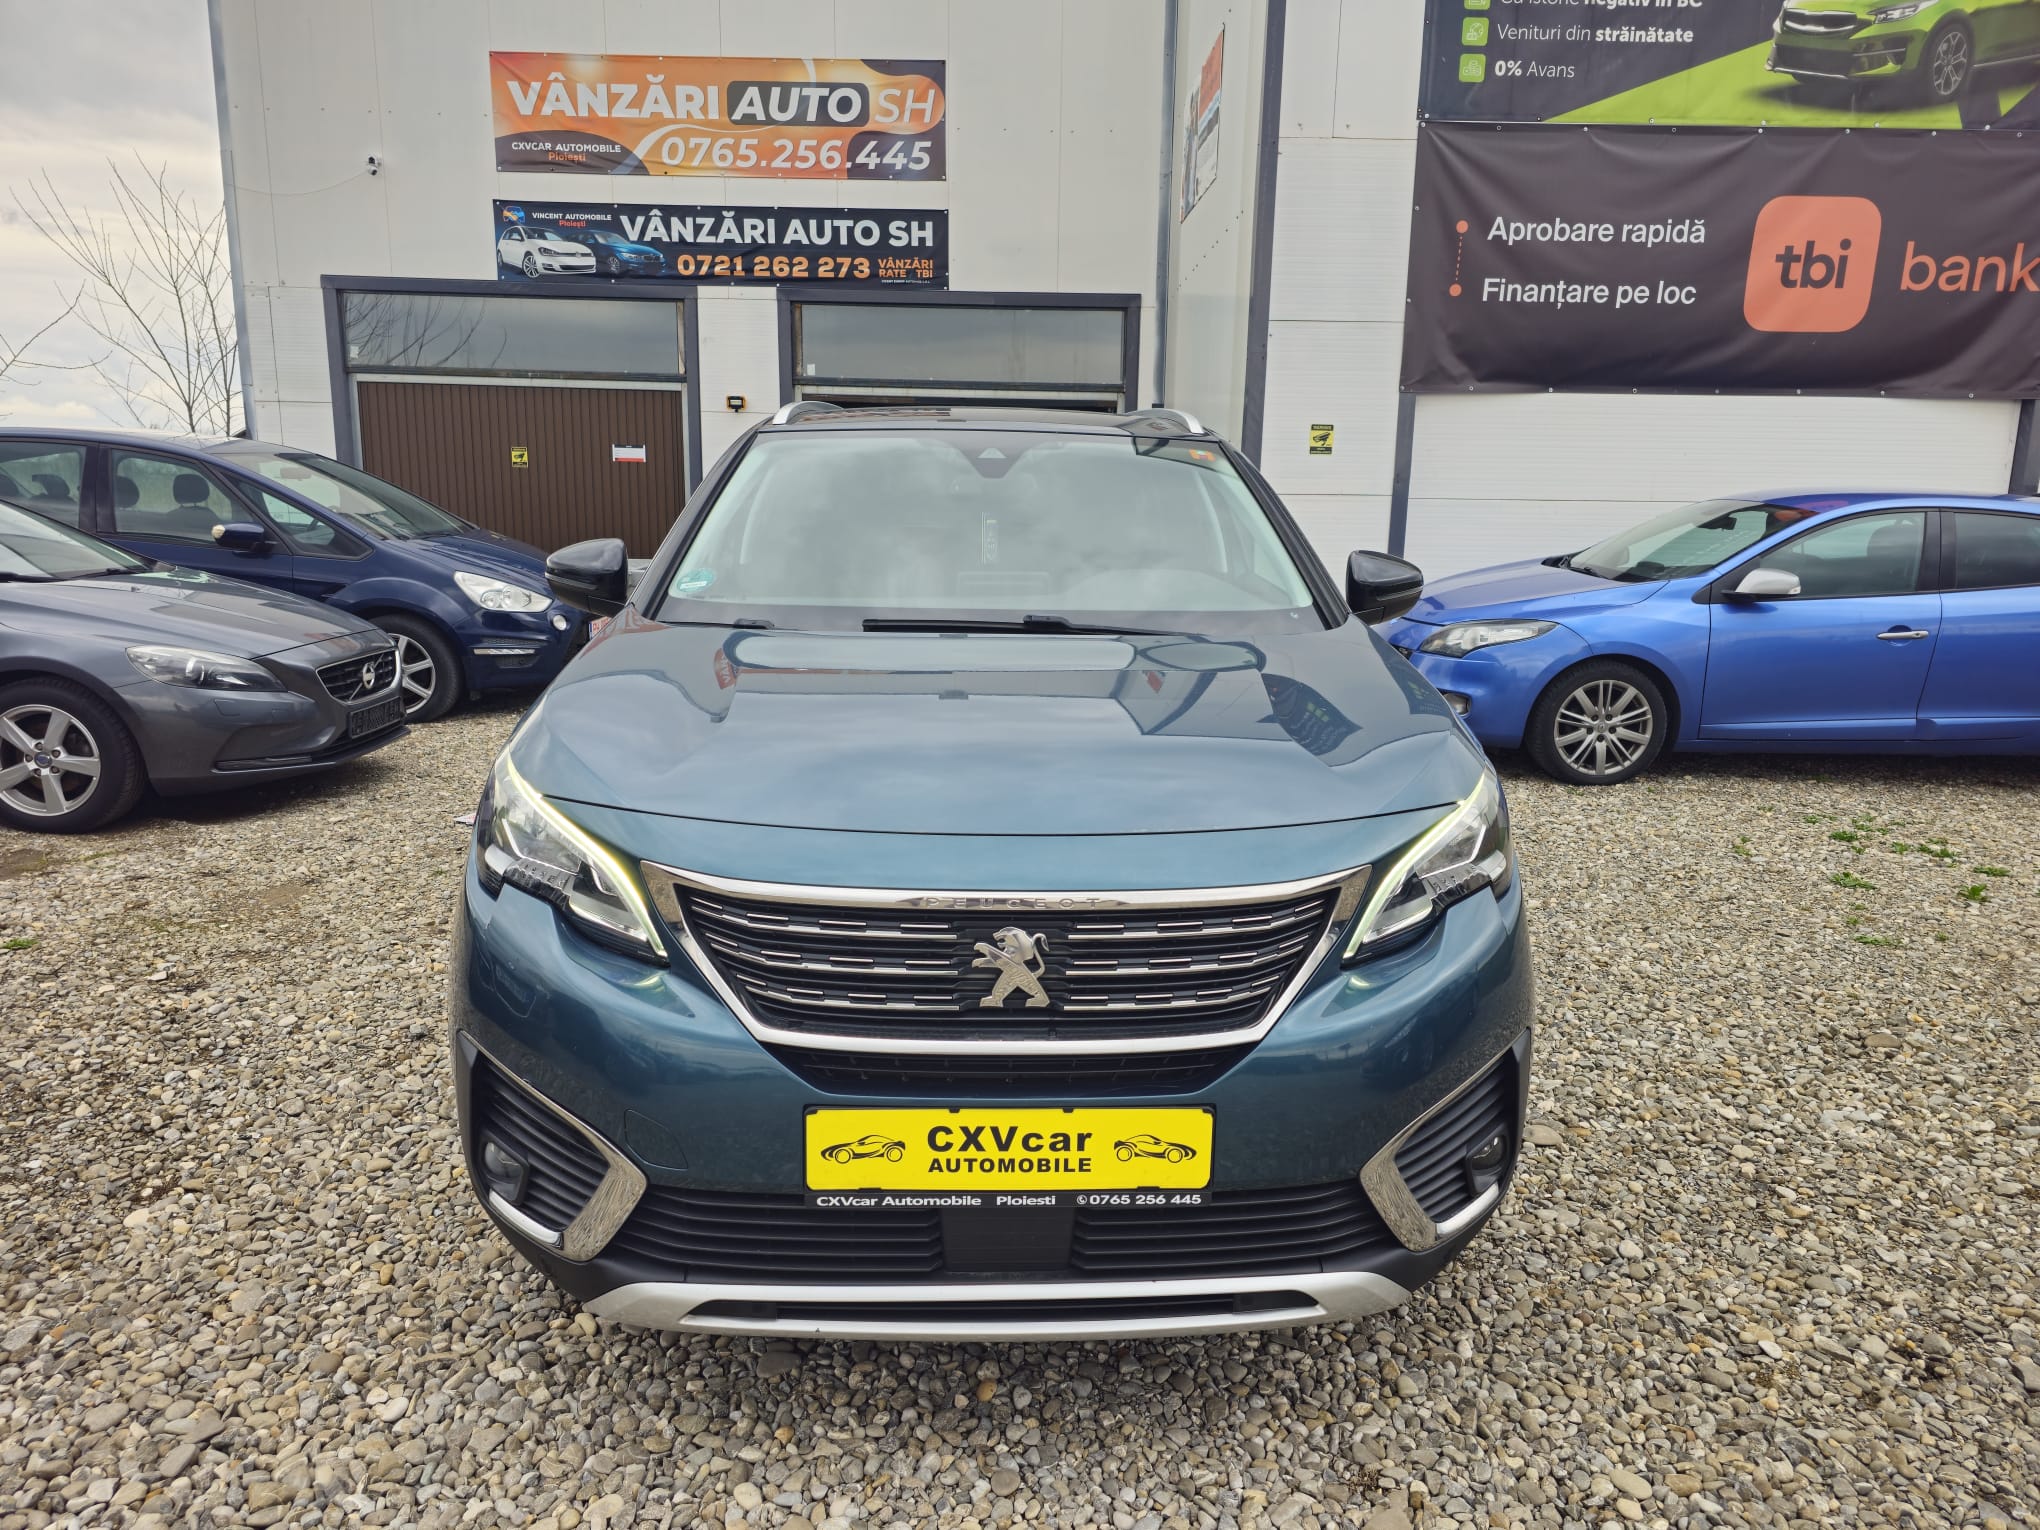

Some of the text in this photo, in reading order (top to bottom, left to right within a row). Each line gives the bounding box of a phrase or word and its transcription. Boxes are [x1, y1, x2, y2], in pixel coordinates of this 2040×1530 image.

[1497, 24, 1694, 43] Venituri din străinătate
[1494, 60, 1575, 78] 0% Avans
[506, 72, 935, 124] VÂNZĂRI AUTO SH
[511, 142, 621, 153] CXVCAR AUTOMOBILE
[661, 136, 932, 171] 0765.256.445
[565, 213, 612, 221] AUTOMOBILE
[620, 208, 933, 247] VÂNZĂRI AUTO SH
[1487, 216, 1706, 248] Aprobare rapidă
[677, 254, 871, 279] 0721 262 273
[878, 256, 933, 269] VÂNZĂRI
[879, 268, 933, 278] RATE TBI
[1775, 238, 2040, 292] tbi bank
[1482, 278, 1697, 309] Finanțare pe loc
[927, 1125, 1093, 1152] CXVcar
[928, 1157, 1092, 1173] AUTOMOBILE
[816, 1194, 1201, 1207] CXVcar Automobile Ploiesti 0765 256 445
